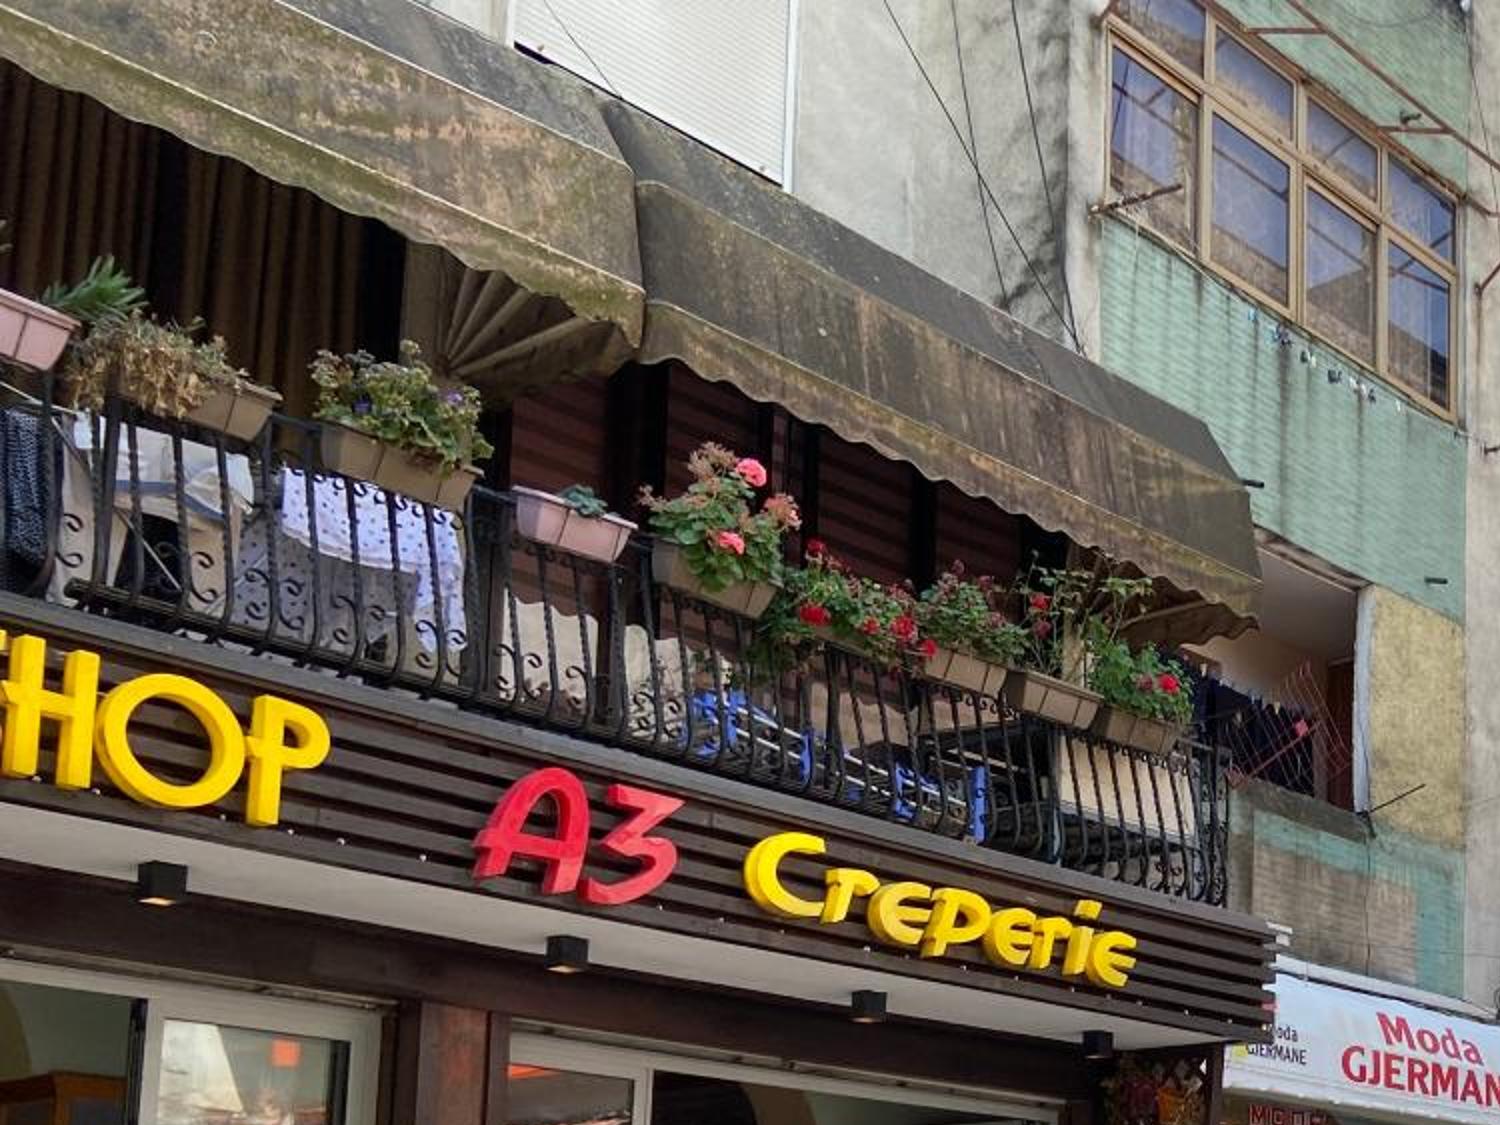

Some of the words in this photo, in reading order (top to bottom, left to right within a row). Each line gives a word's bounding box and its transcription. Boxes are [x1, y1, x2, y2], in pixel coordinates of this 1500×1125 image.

[0, 629, 331, 826] HOP
[472, 767, 686, 905] A3
[743, 831, 1137, 988] Creperie
[1376, 1012, 1484, 1066] Moda
